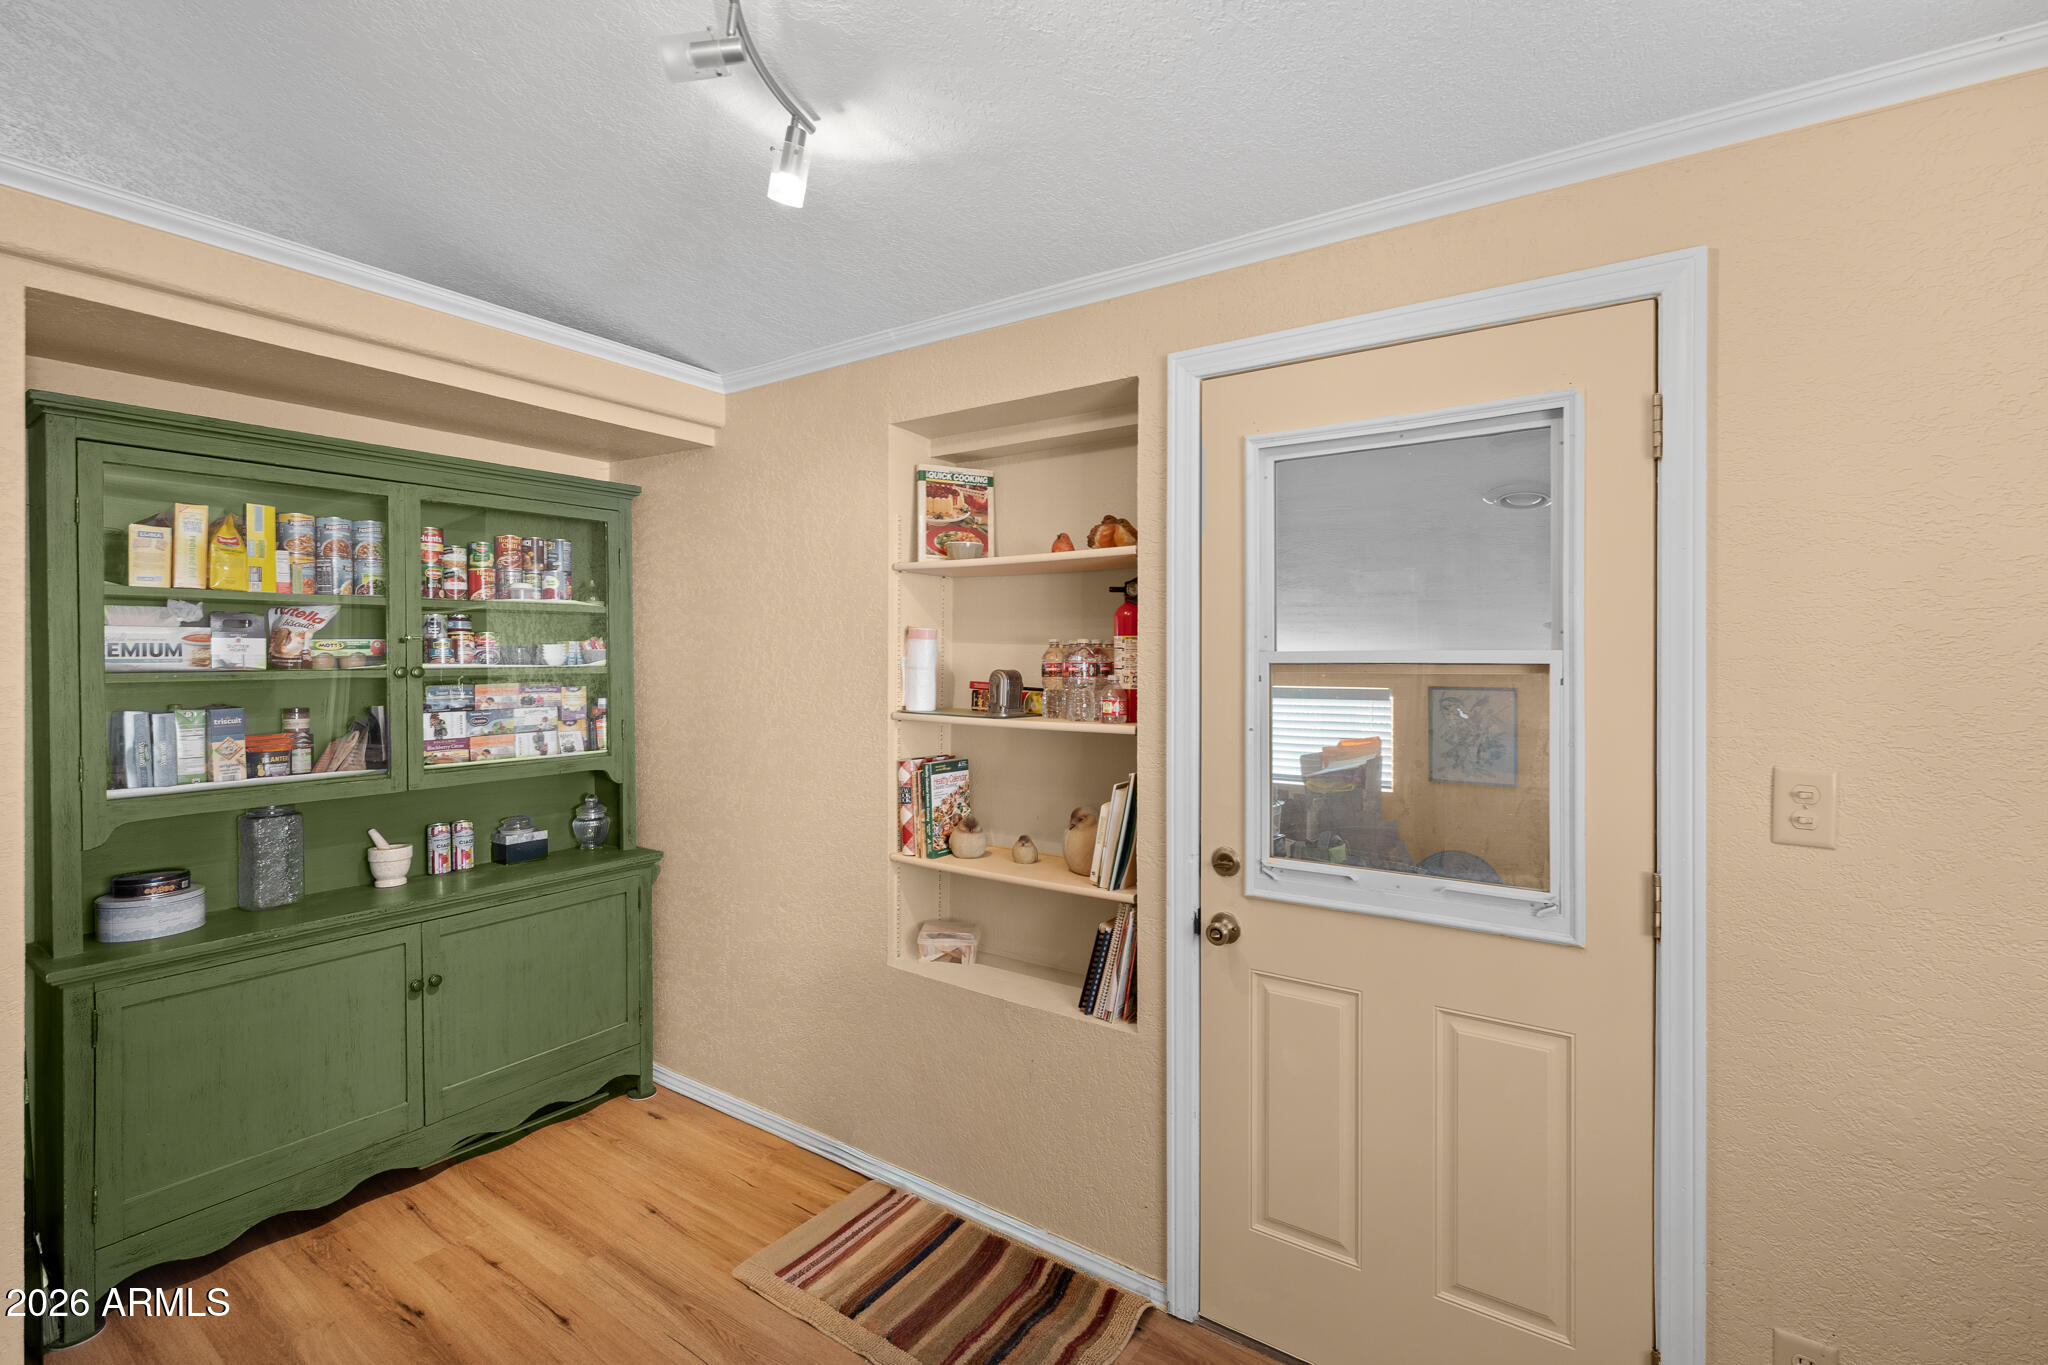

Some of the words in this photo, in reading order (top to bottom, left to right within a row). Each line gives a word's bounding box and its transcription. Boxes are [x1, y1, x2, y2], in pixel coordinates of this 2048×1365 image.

[928, 471, 952, 480] QUICK
[953, 474, 988, 483] COOKING
[275, 607, 326, 625] nutella
[107, 642, 183, 657] EMIUM
[213, 717, 242, 725] triscuit
